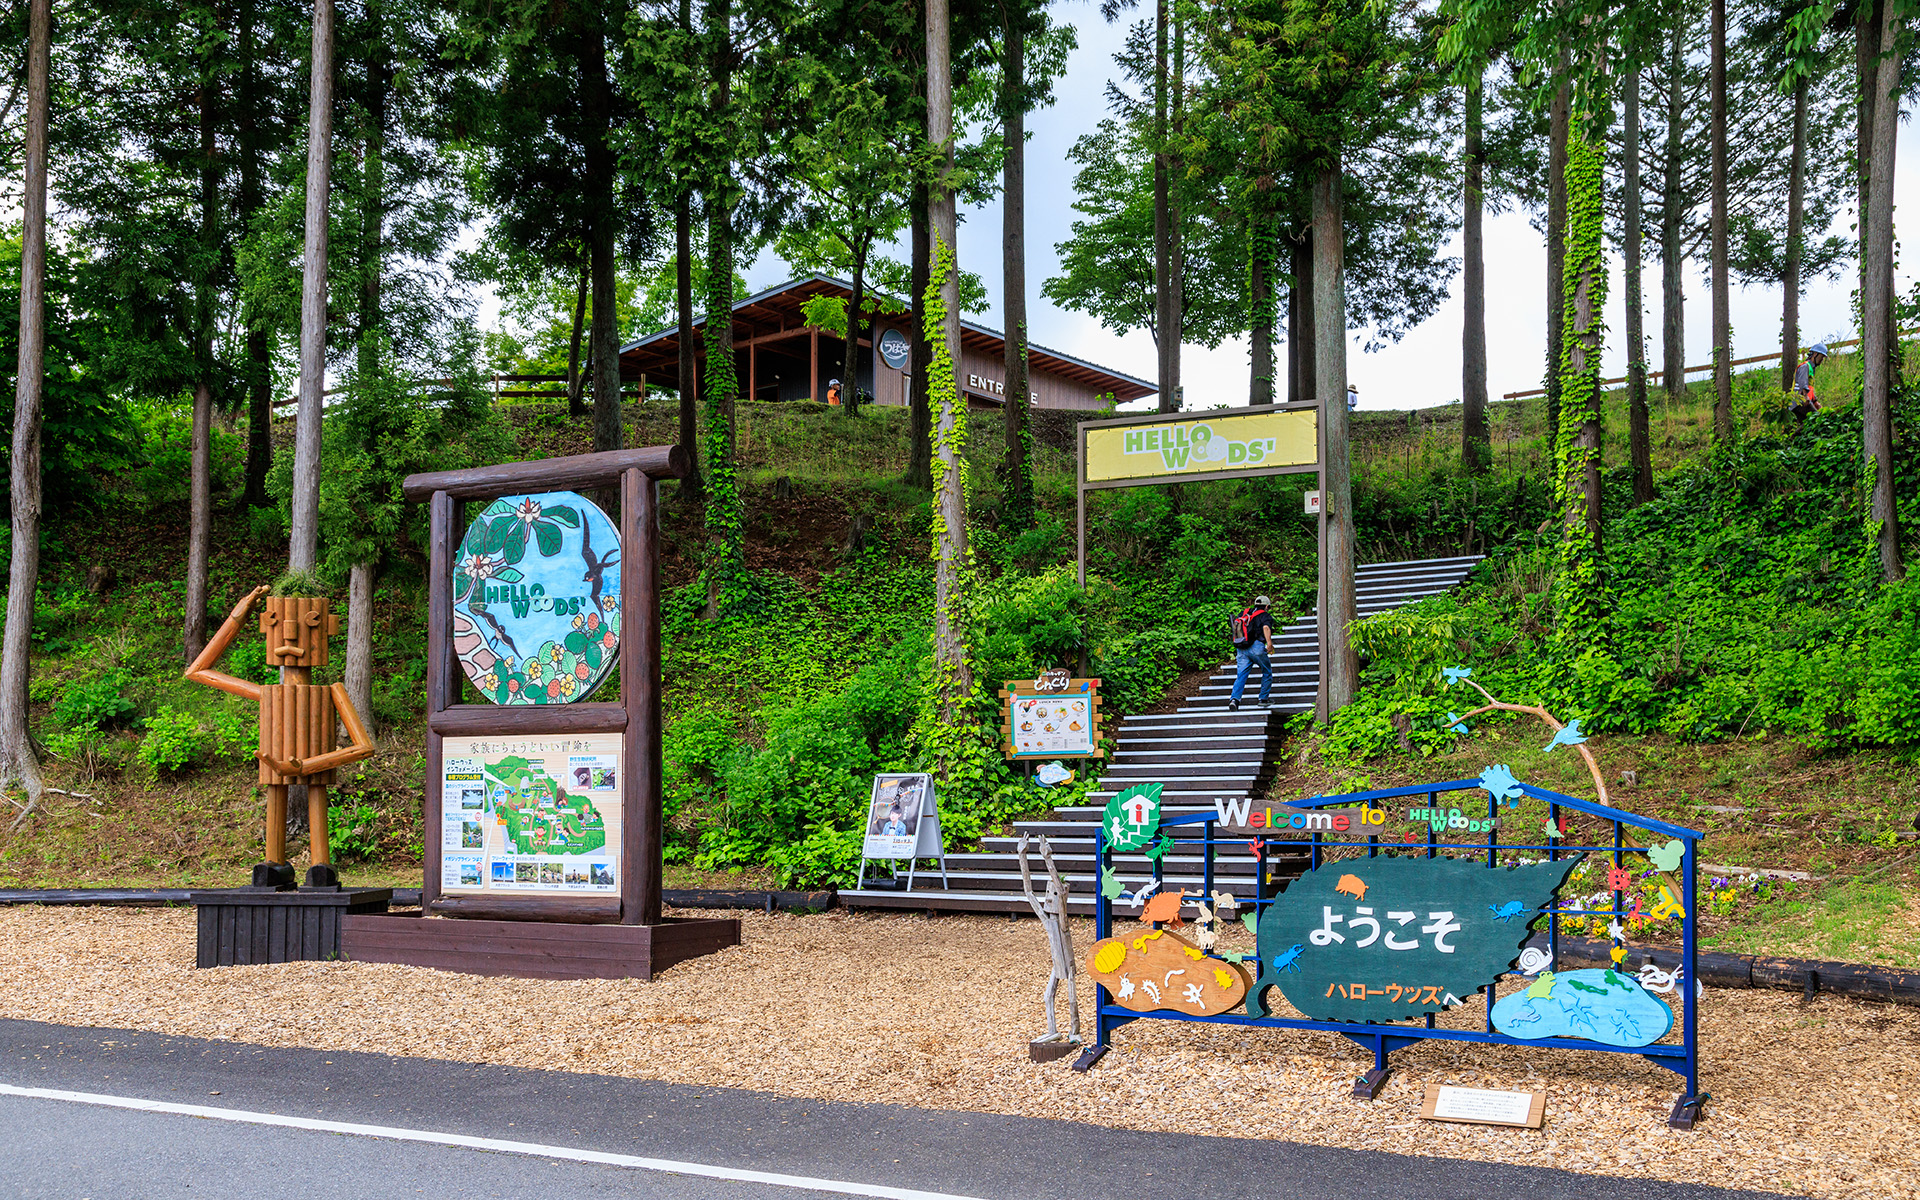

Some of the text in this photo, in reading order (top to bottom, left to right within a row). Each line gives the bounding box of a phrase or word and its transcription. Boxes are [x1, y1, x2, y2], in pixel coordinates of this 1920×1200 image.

[969, 373, 1038, 405] ENTRE
[1125, 425, 1212, 453] HELLO
[486, 582, 545, 604] HELLO
[469, 739, 592, 755] 家族にちょうどいい冒険を
[1214, 798, 1386, 831] Welcome to
[1409, 808, 1462, 822] HELLO
[1309, 905, 1461, 954] ようこそ
